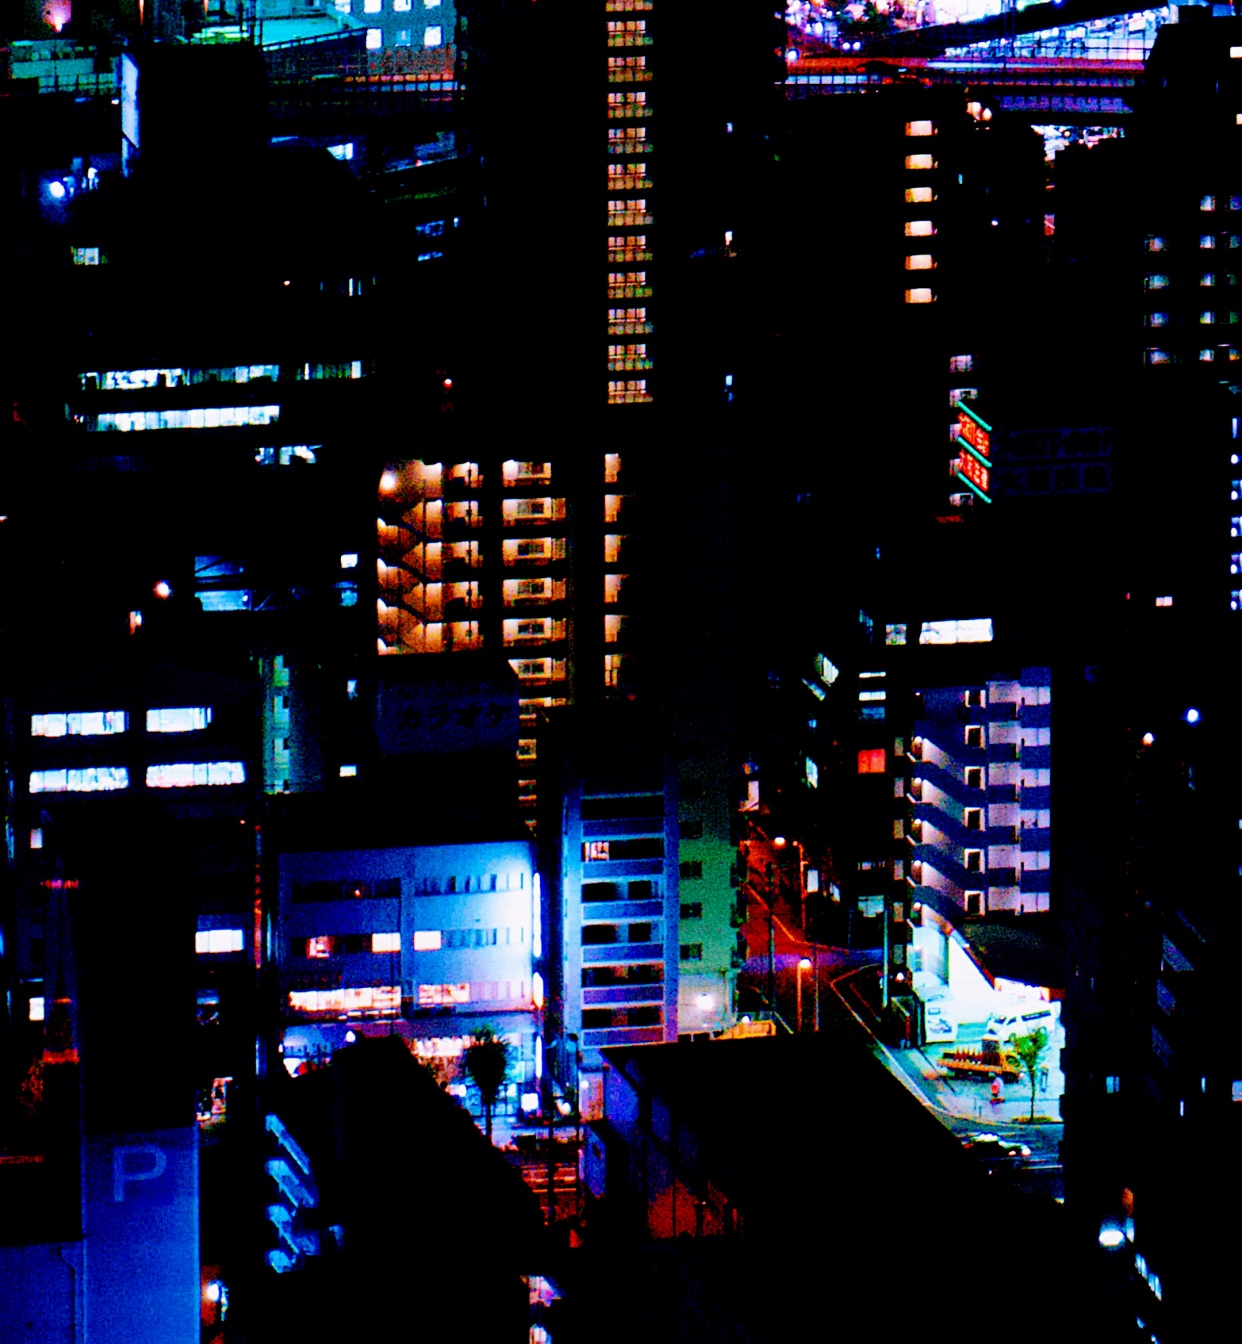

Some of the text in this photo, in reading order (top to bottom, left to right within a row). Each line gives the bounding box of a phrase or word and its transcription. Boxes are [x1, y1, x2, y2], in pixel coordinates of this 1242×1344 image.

[398, 704, 510, 730] カラオケ
[113, 1141, 167, 1203] P
